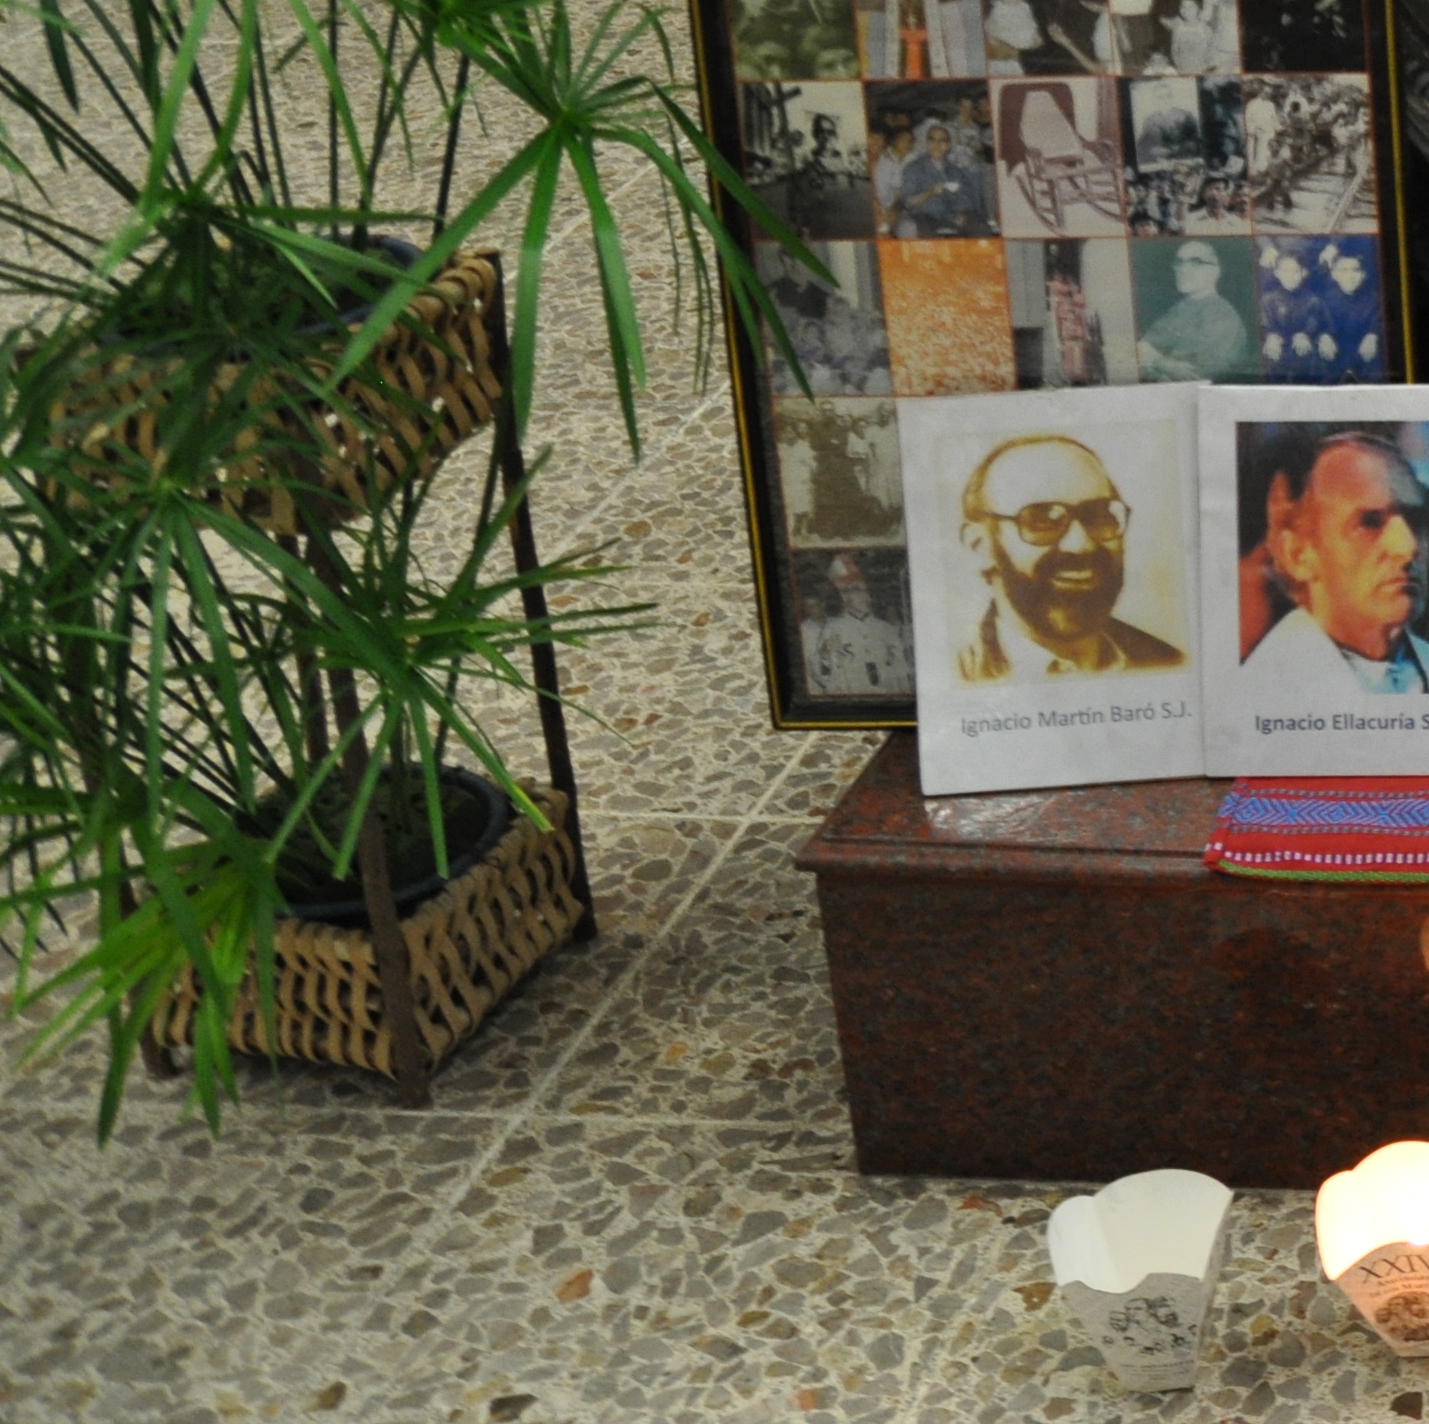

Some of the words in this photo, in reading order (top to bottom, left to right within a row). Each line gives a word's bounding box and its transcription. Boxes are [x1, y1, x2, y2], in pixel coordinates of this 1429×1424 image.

[961, 713, 1032, 738] Ignacio
[1038, 707, 1104, 727] Martín
[1110, 703, 1155, 723] Baró
[1161, 700, 1193, 719] S.J.
[1255, 714, 1326, 735] Ignacio
[1332, 713, 1416, 730] Ellacuría
